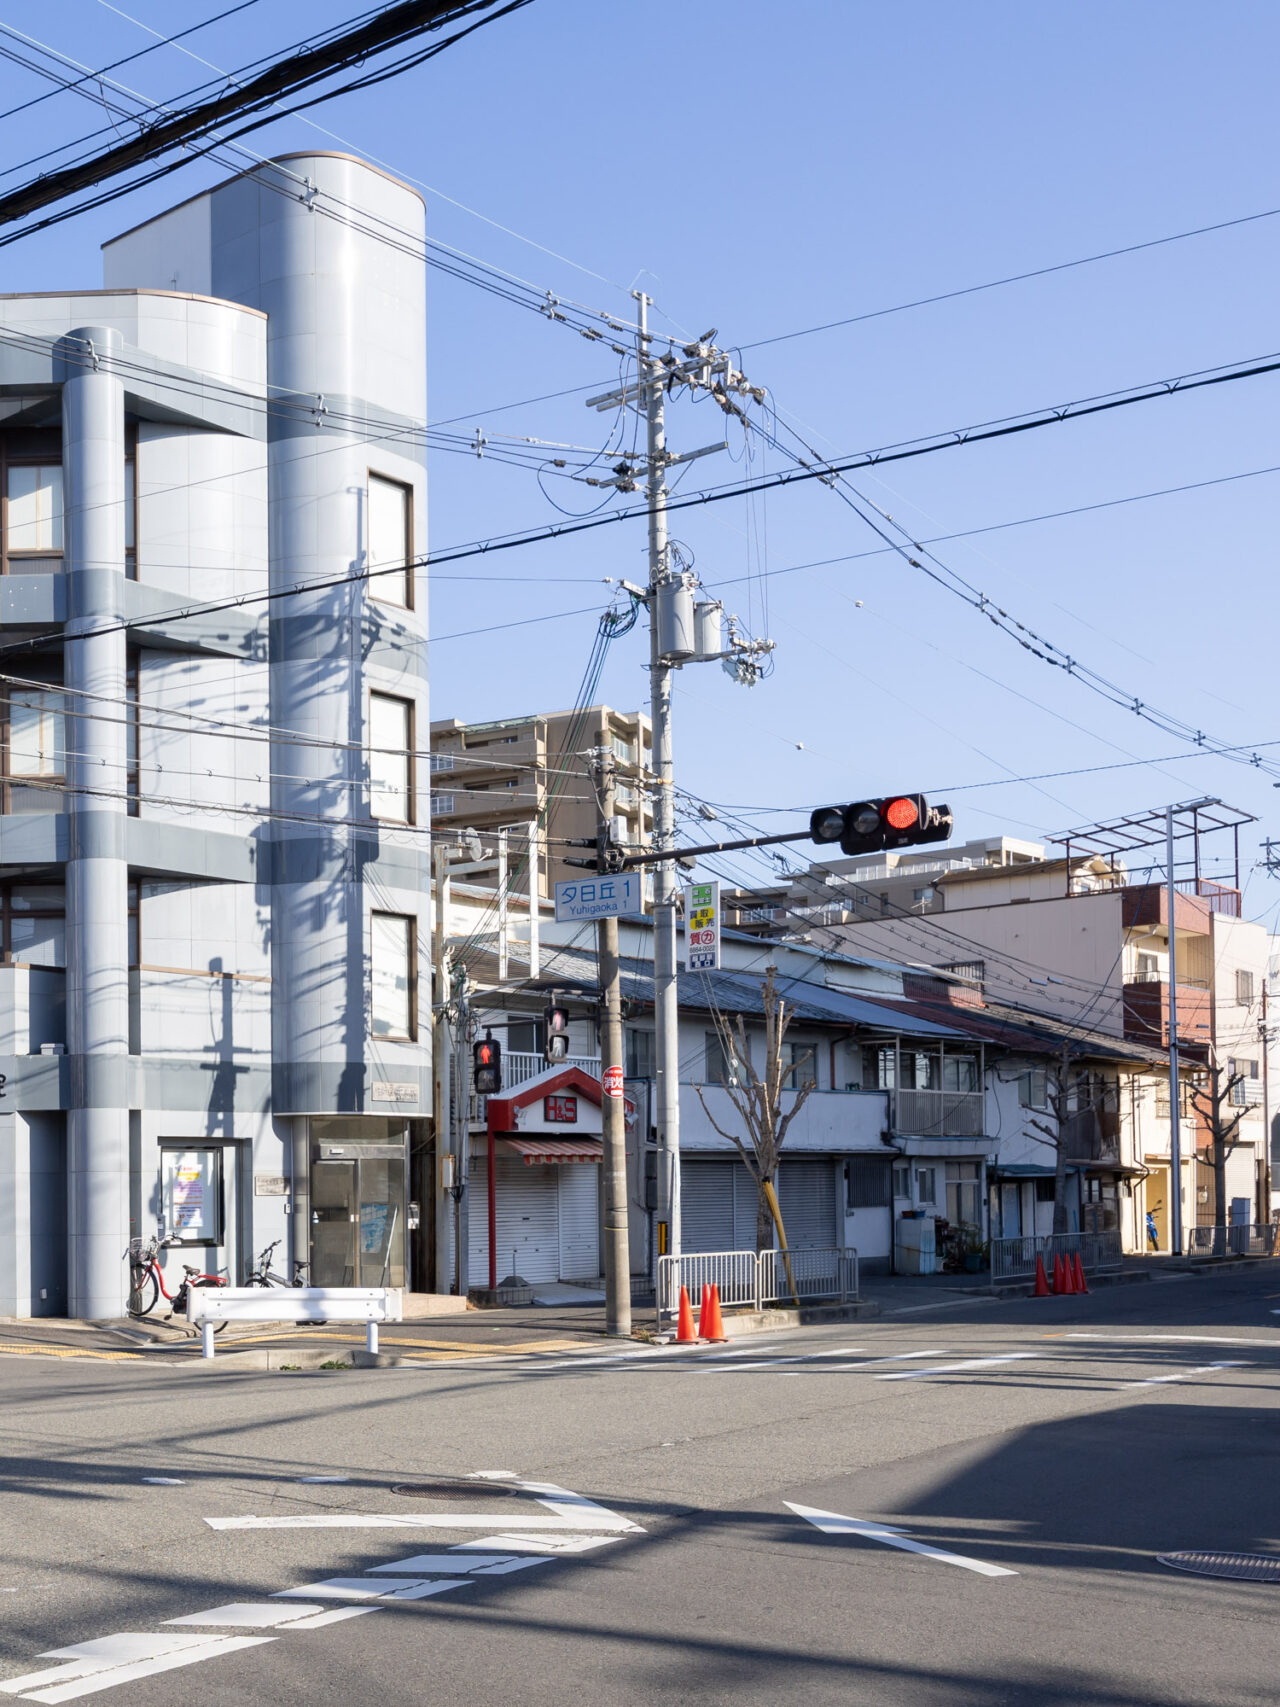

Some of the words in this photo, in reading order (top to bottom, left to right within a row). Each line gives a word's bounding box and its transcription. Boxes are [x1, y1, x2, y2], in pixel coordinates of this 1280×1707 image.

[569, 902, 618, 915] Yuhigaoka
[604, 1075, 624, 1089] 消火
[547, 1097, 576, 1121] H&S
